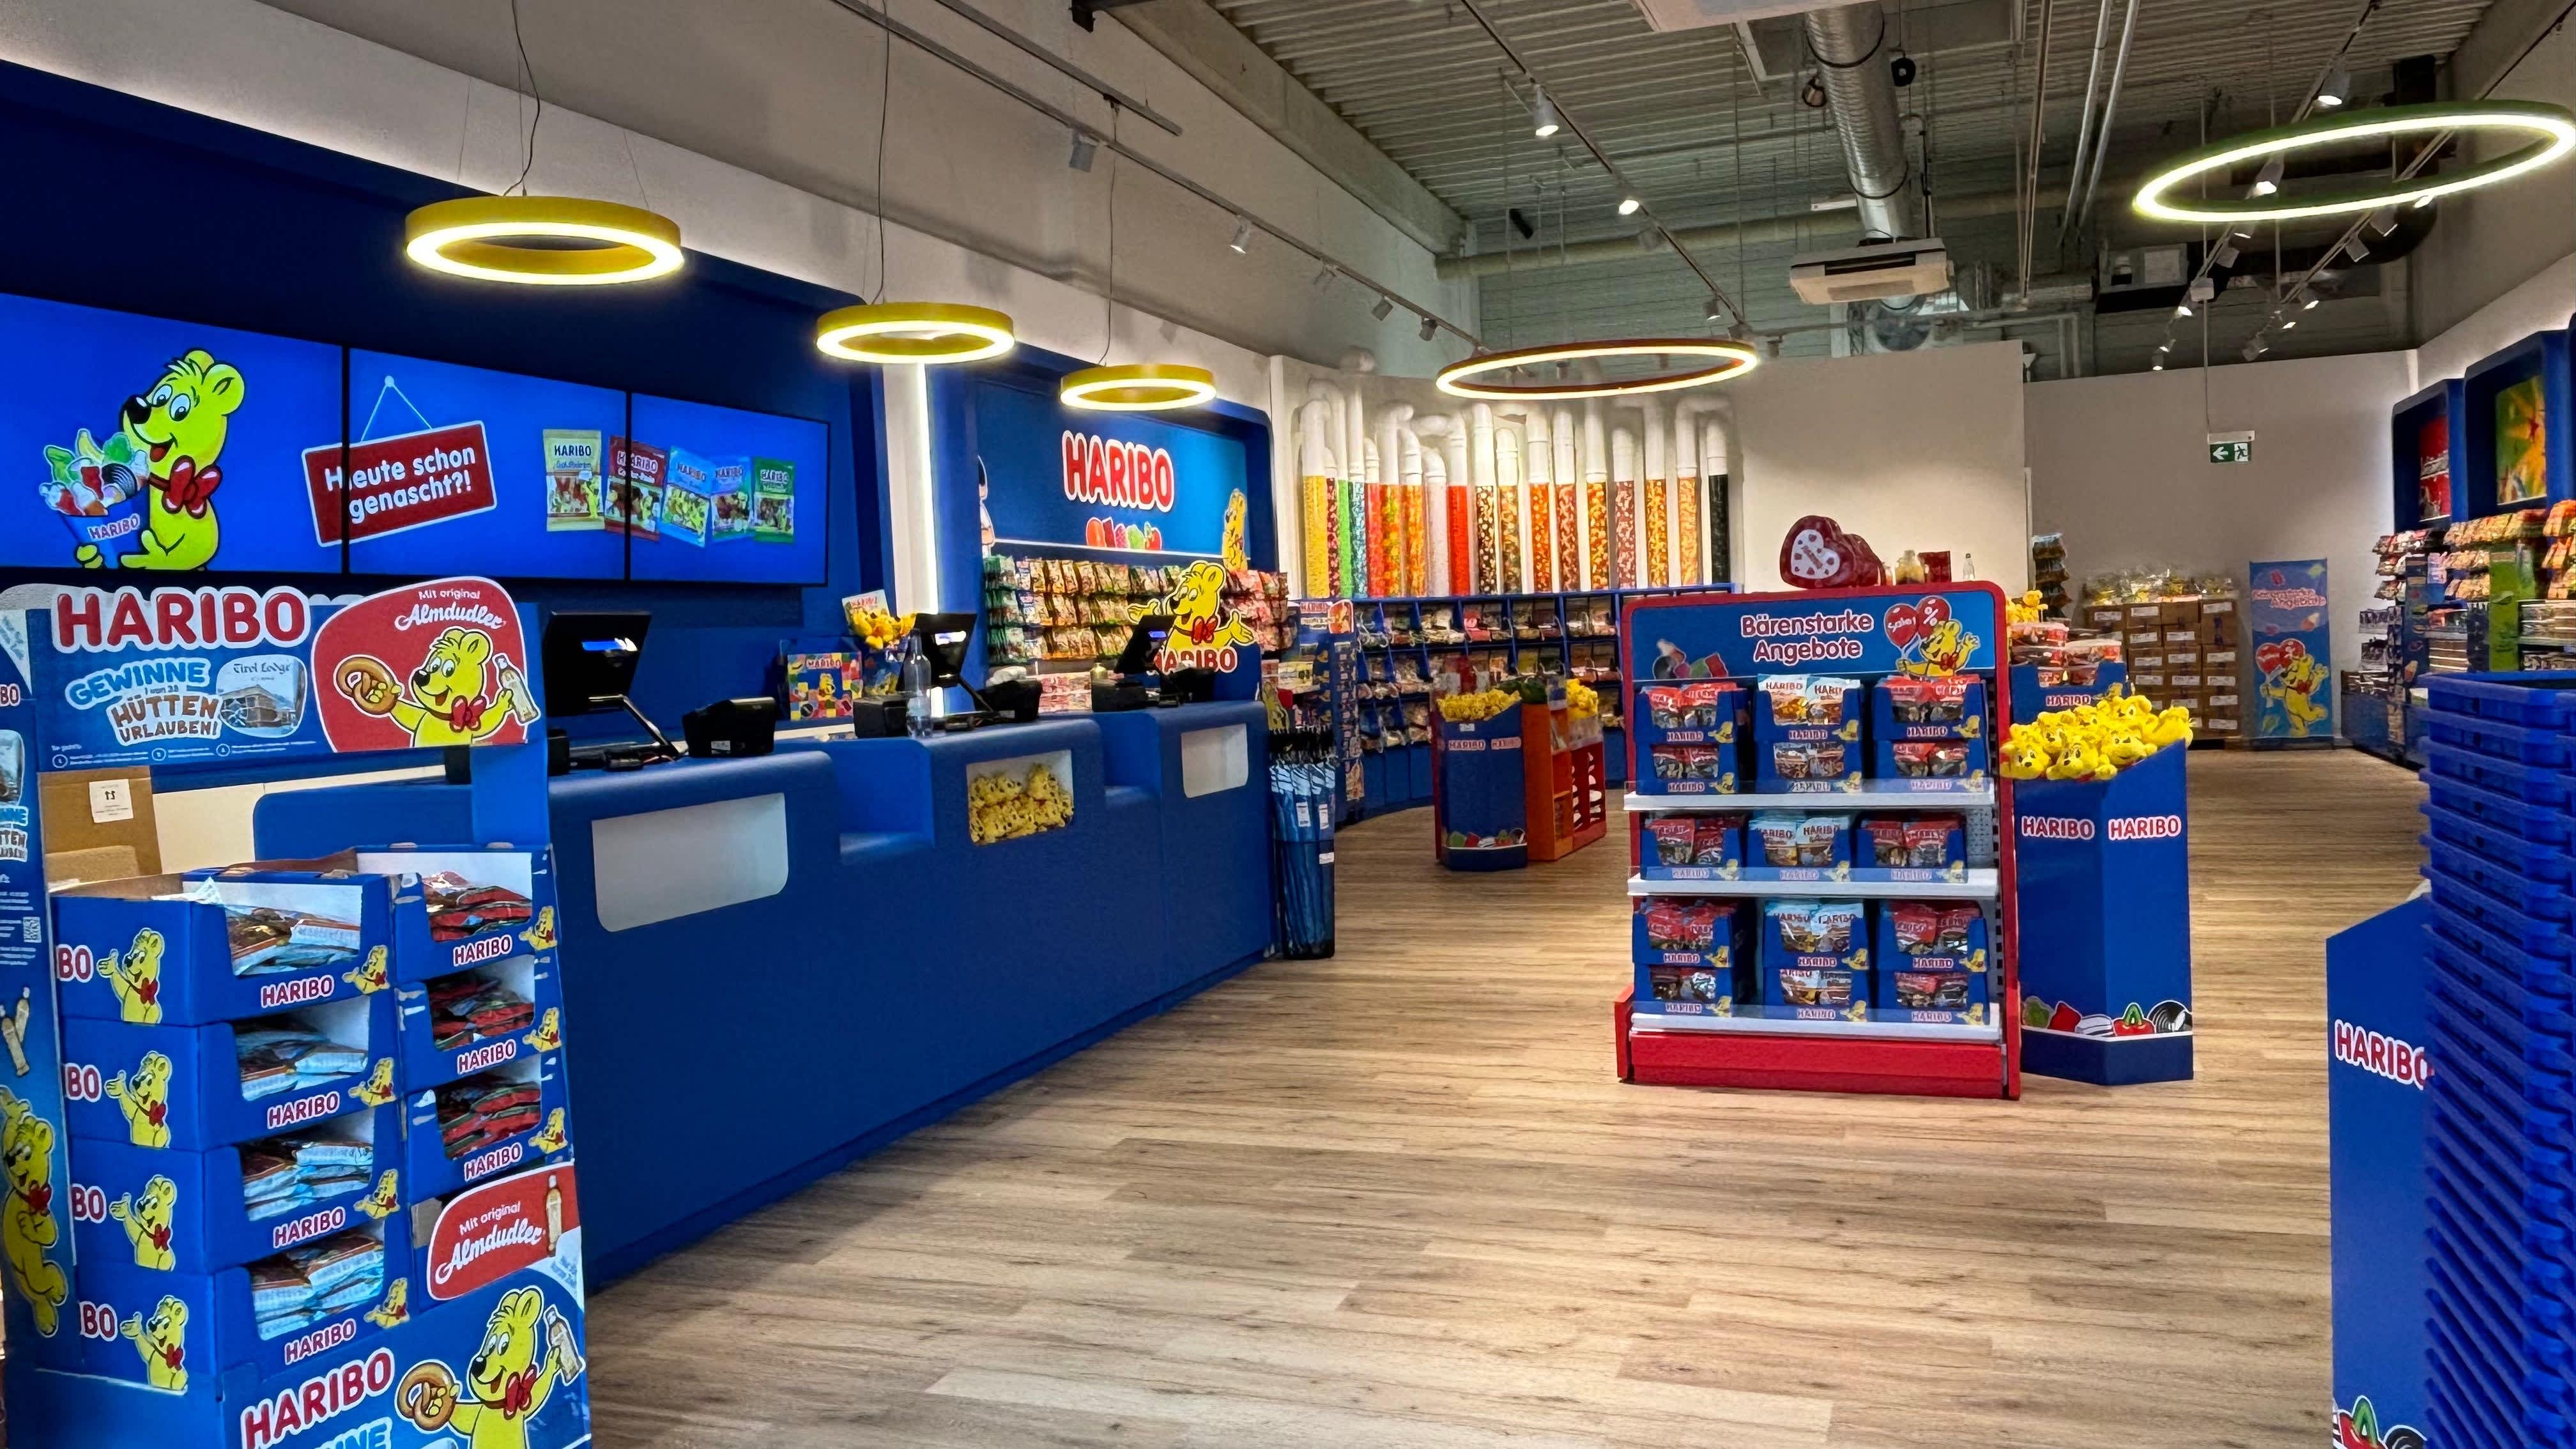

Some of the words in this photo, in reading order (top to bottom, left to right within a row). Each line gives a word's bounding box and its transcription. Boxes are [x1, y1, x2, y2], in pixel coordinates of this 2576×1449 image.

[555, 445, 591, 456] HARIBO
[325, 460, 406, 491] Heute
[413, 447, 475, 476] schon
[1064, 433, 1173, 510] HARIBO
[349, 470, 471, 524] genascht?!
[88, 515, 139, 539] HARIBO
[418, 590, 437, 600] Mit
[440, 588, 480, 599] original
[54, 590, 308, 650] HARIBO
[395, 601, 506, 629] Almdudler
[1742, 610, 1873, 636] Bärenstarke
[1754, 637, 1861, 665] Angebote
[68, 661, 206, 705] GEWINNE
[111, 694, 218, 727] HÜTTEN
[2046, 695, 2090, 706] HARIBO
[119, 721, 218, 742] URLAUBEN!
[2023, 817, 2094, 838] HARIBO
[2110, 816, 2181, 839] HARIBO
[454, 936, 511, 965] HARIBO
[1913, 958, 1953, 968] HARIBO
[263, 977, 333, 1007] HARIBO
[458, 1041, 516, 1073] HARIBO
[269, 1092, 339, 1128] HARIBO
[465, 1144, 521, 1181] HARIBO
[274, 1209, 344, 1247] HARIBO
[459, 1217, 478, 1235] Mit
[481, 1202, 521, 1223] original
[436, 1218, 544, 1284] Almdudler
[286, 1321, 355, 1363] HARIBO
[244, 1351, 393, 1449] HARIBO
